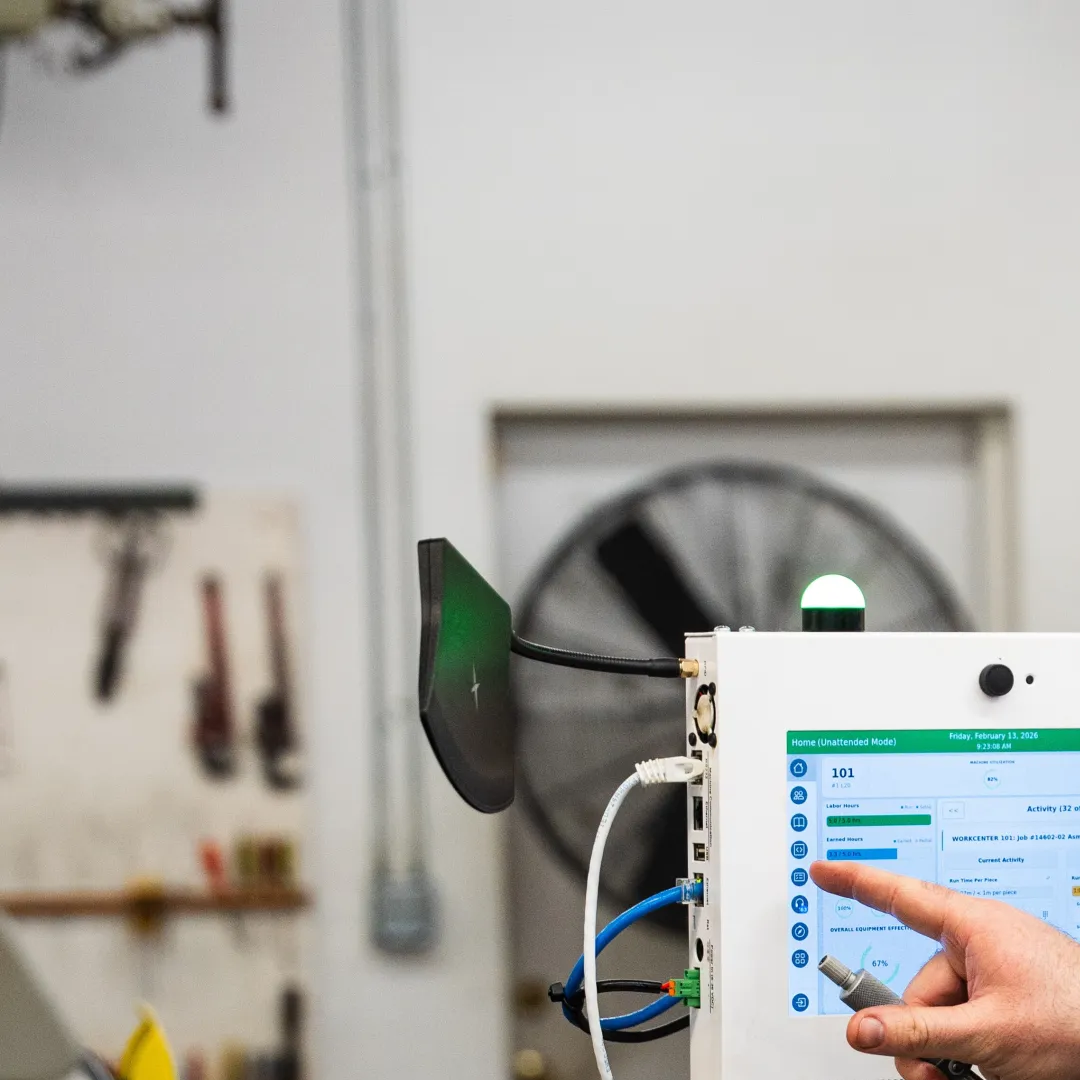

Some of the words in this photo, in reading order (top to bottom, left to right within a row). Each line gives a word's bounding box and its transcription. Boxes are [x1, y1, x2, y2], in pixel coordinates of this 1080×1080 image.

[949, 732, 973, 740] Friday,
[974, 732, 1006, 740] February
[1008, 732, 1018, 740] 13,
[792, 738, 816, 747] Home
[818, 737, 868, 747] (Unattended
[871, 736, 897, 746] Mode)
[832, 768, 854, 778] 101
